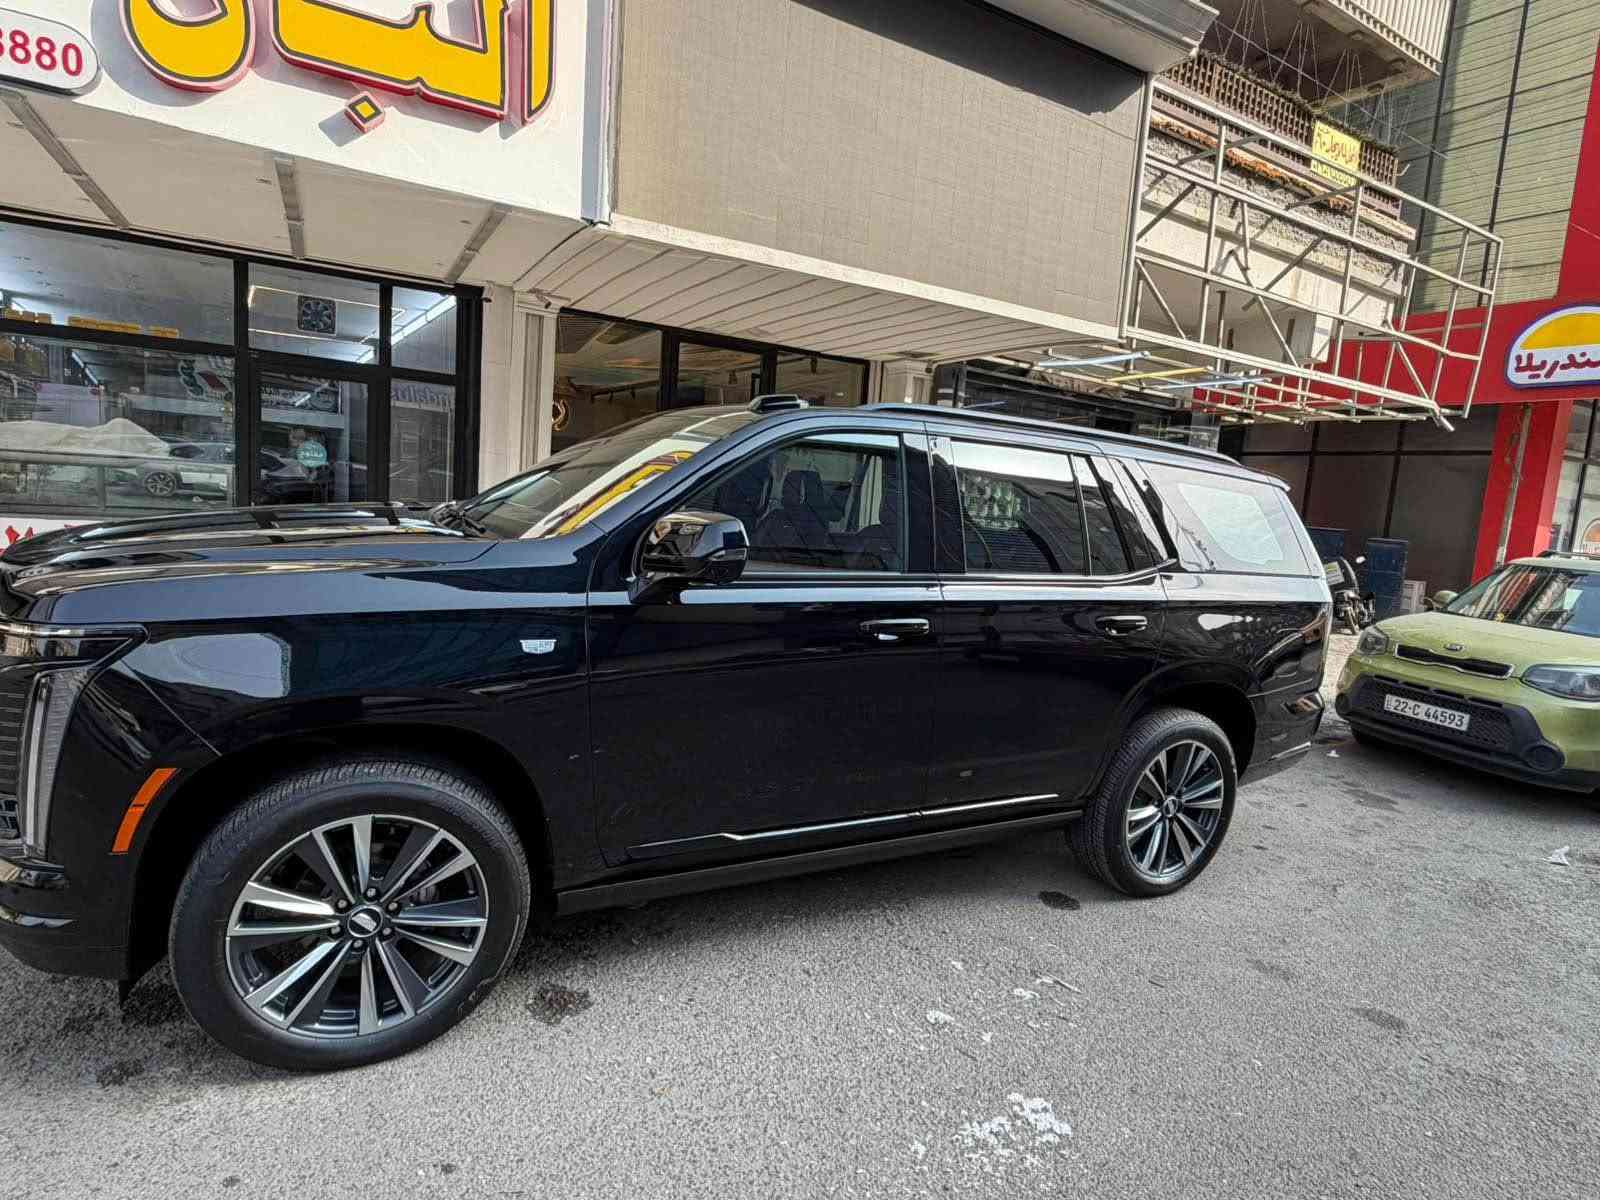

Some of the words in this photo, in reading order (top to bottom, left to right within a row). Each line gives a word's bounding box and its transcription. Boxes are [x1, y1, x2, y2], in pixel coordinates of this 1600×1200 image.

[0, 28, 83, 76] 880
[1515, 352, 1600, 379] ندريلا
[1425, 707, 1465, 727] 44593
